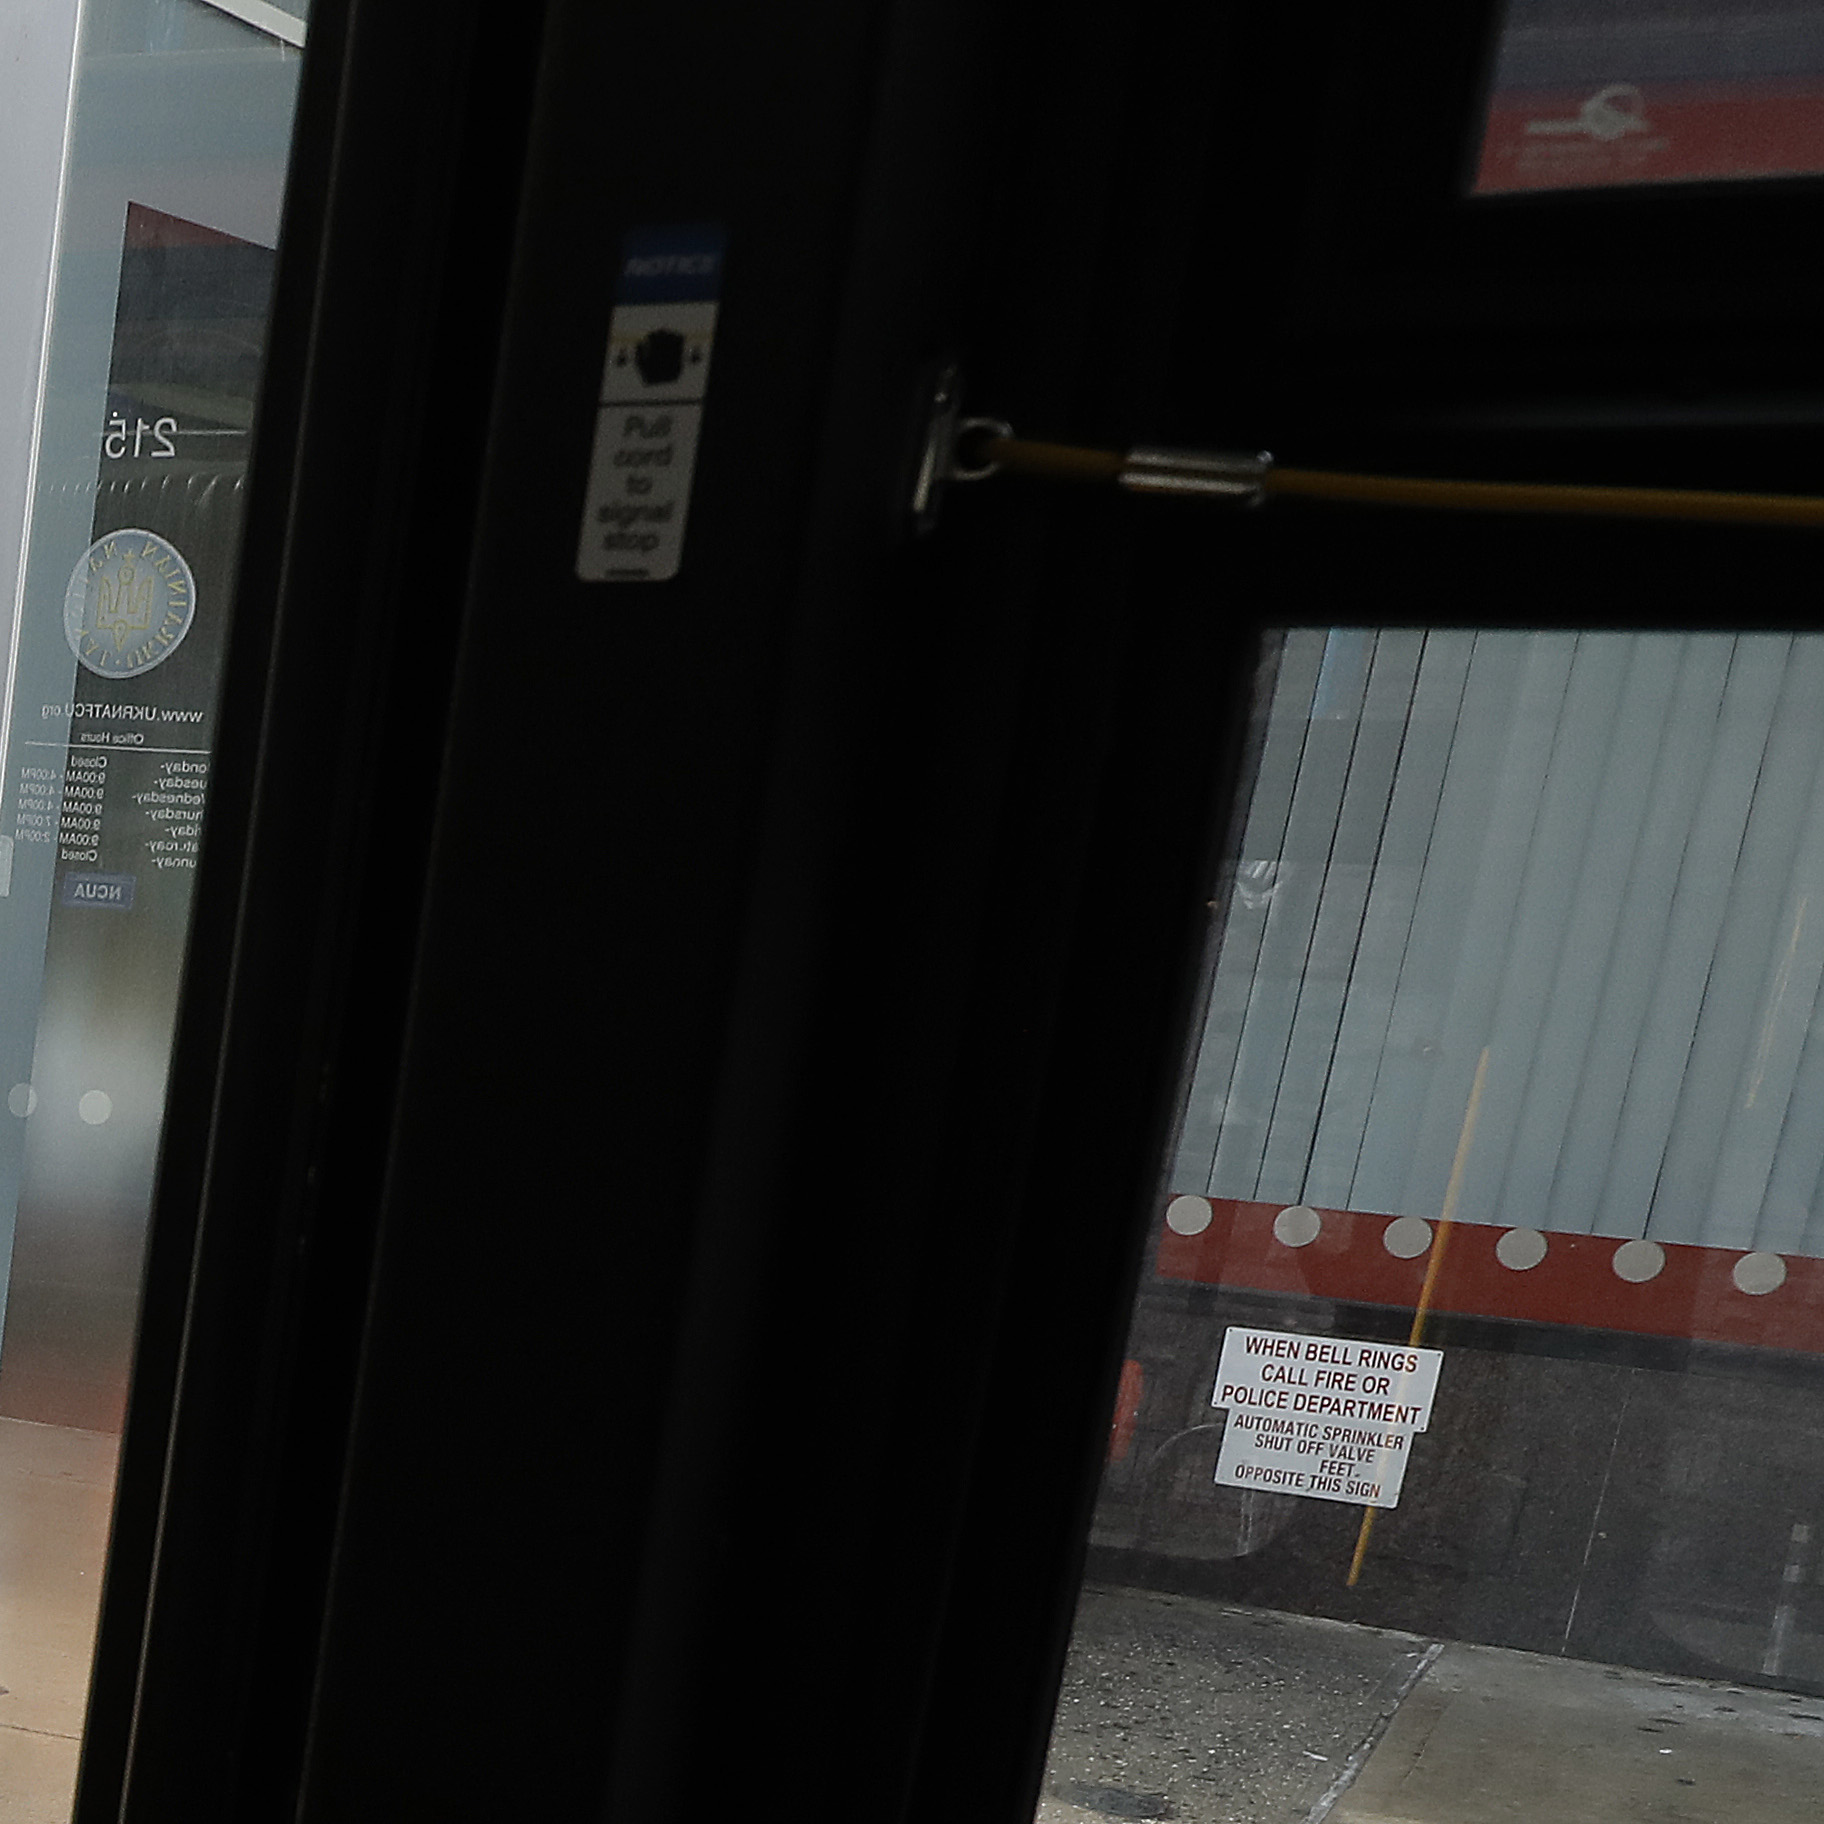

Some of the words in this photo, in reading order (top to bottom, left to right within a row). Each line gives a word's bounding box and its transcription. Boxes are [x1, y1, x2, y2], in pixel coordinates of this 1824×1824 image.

[1245, 1336, 1301, 1359] WHEN
[1305, 1343, 1353, 1366] BELL
[1358, 1349, 1419, 1373] RINGS
[1261, 1364, 1308, 1387] CALL
[1314, 1370, 1357, 1392] FIRE
[1362, 1375, 1390, 1396] OR
[1221, 1385, 1288, 1409] POLICE
[1293, 1392, 1422, 1425] DEPARTMENT
[1234, 1414, 1318, 1438] AUTOMATIC
[1322, 1425, 1404, 1450] SPRINKLER
[1254, 1434, 1292, 1453] SHUT
[1297, 1439, 1324, 1456] OFF
[1328, 1443, 1376, 1463] VALVE
[1235, 1465, 1304, 1487] OPPOSITE
[1309, 1474, 1341, 1493] THIS
[1345, 1479, 1381, 1498] SIGN
